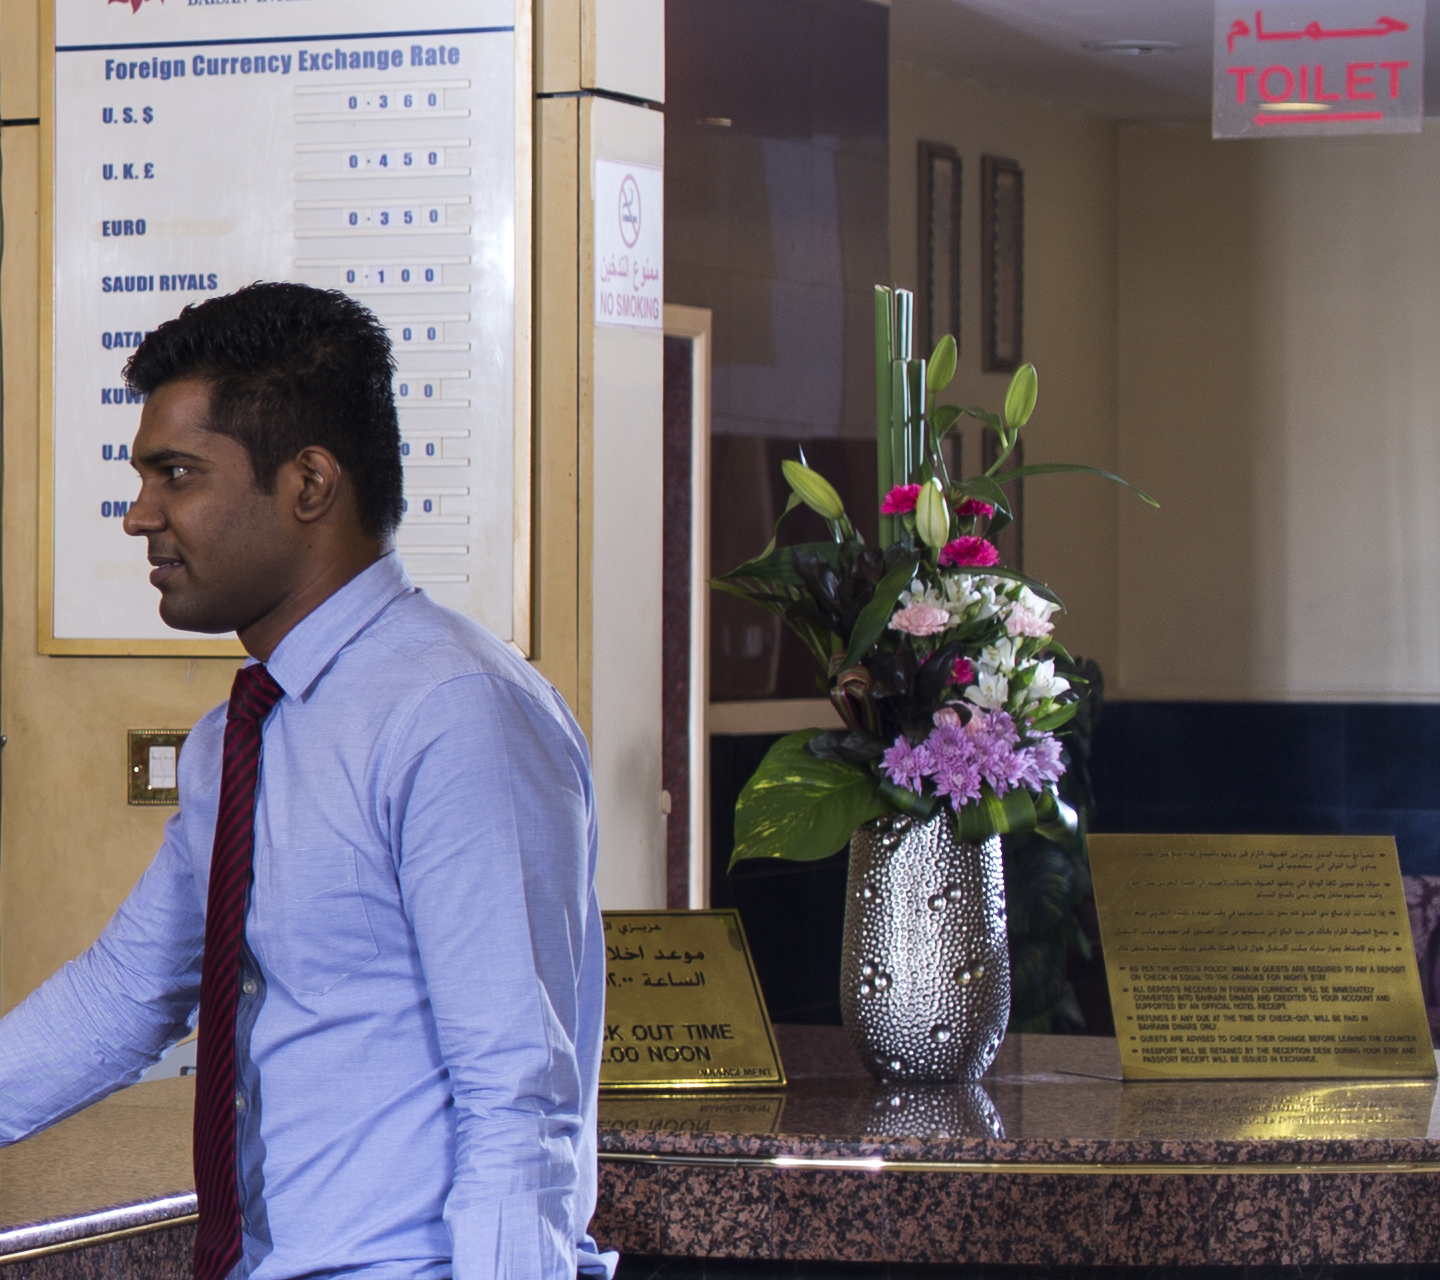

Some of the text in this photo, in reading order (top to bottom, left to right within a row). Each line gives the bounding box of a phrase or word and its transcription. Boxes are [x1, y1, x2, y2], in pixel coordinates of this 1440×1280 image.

[1227, 9, 1410, 54] حمام
[104, 44, 460, 81] Foreign Currency Exchange Rate
[1226, 61, 1410, 104] TOILET
[142, 104, 154, 124] $
[143, 162, 155, 180] £
[102, 218, 147, 238] EURO
[601, 254, 659, 291] ممنوع التدخين
[102, 274, 218, 292] SAUDI RIYALS
[600, 291, 660, 320] NO SMOKING
[102, 332, 150, 349] QATA
[102, 388, 147, 404] KUW
[606, 945, 705, 964] موعد اخلا
[643, 972, 705, 987] الساعة
[632, 1024, 674, 1041] OUT
[682, 1023, 734, 1040] TIME
[648, 1046, 712, 1062] NOON
